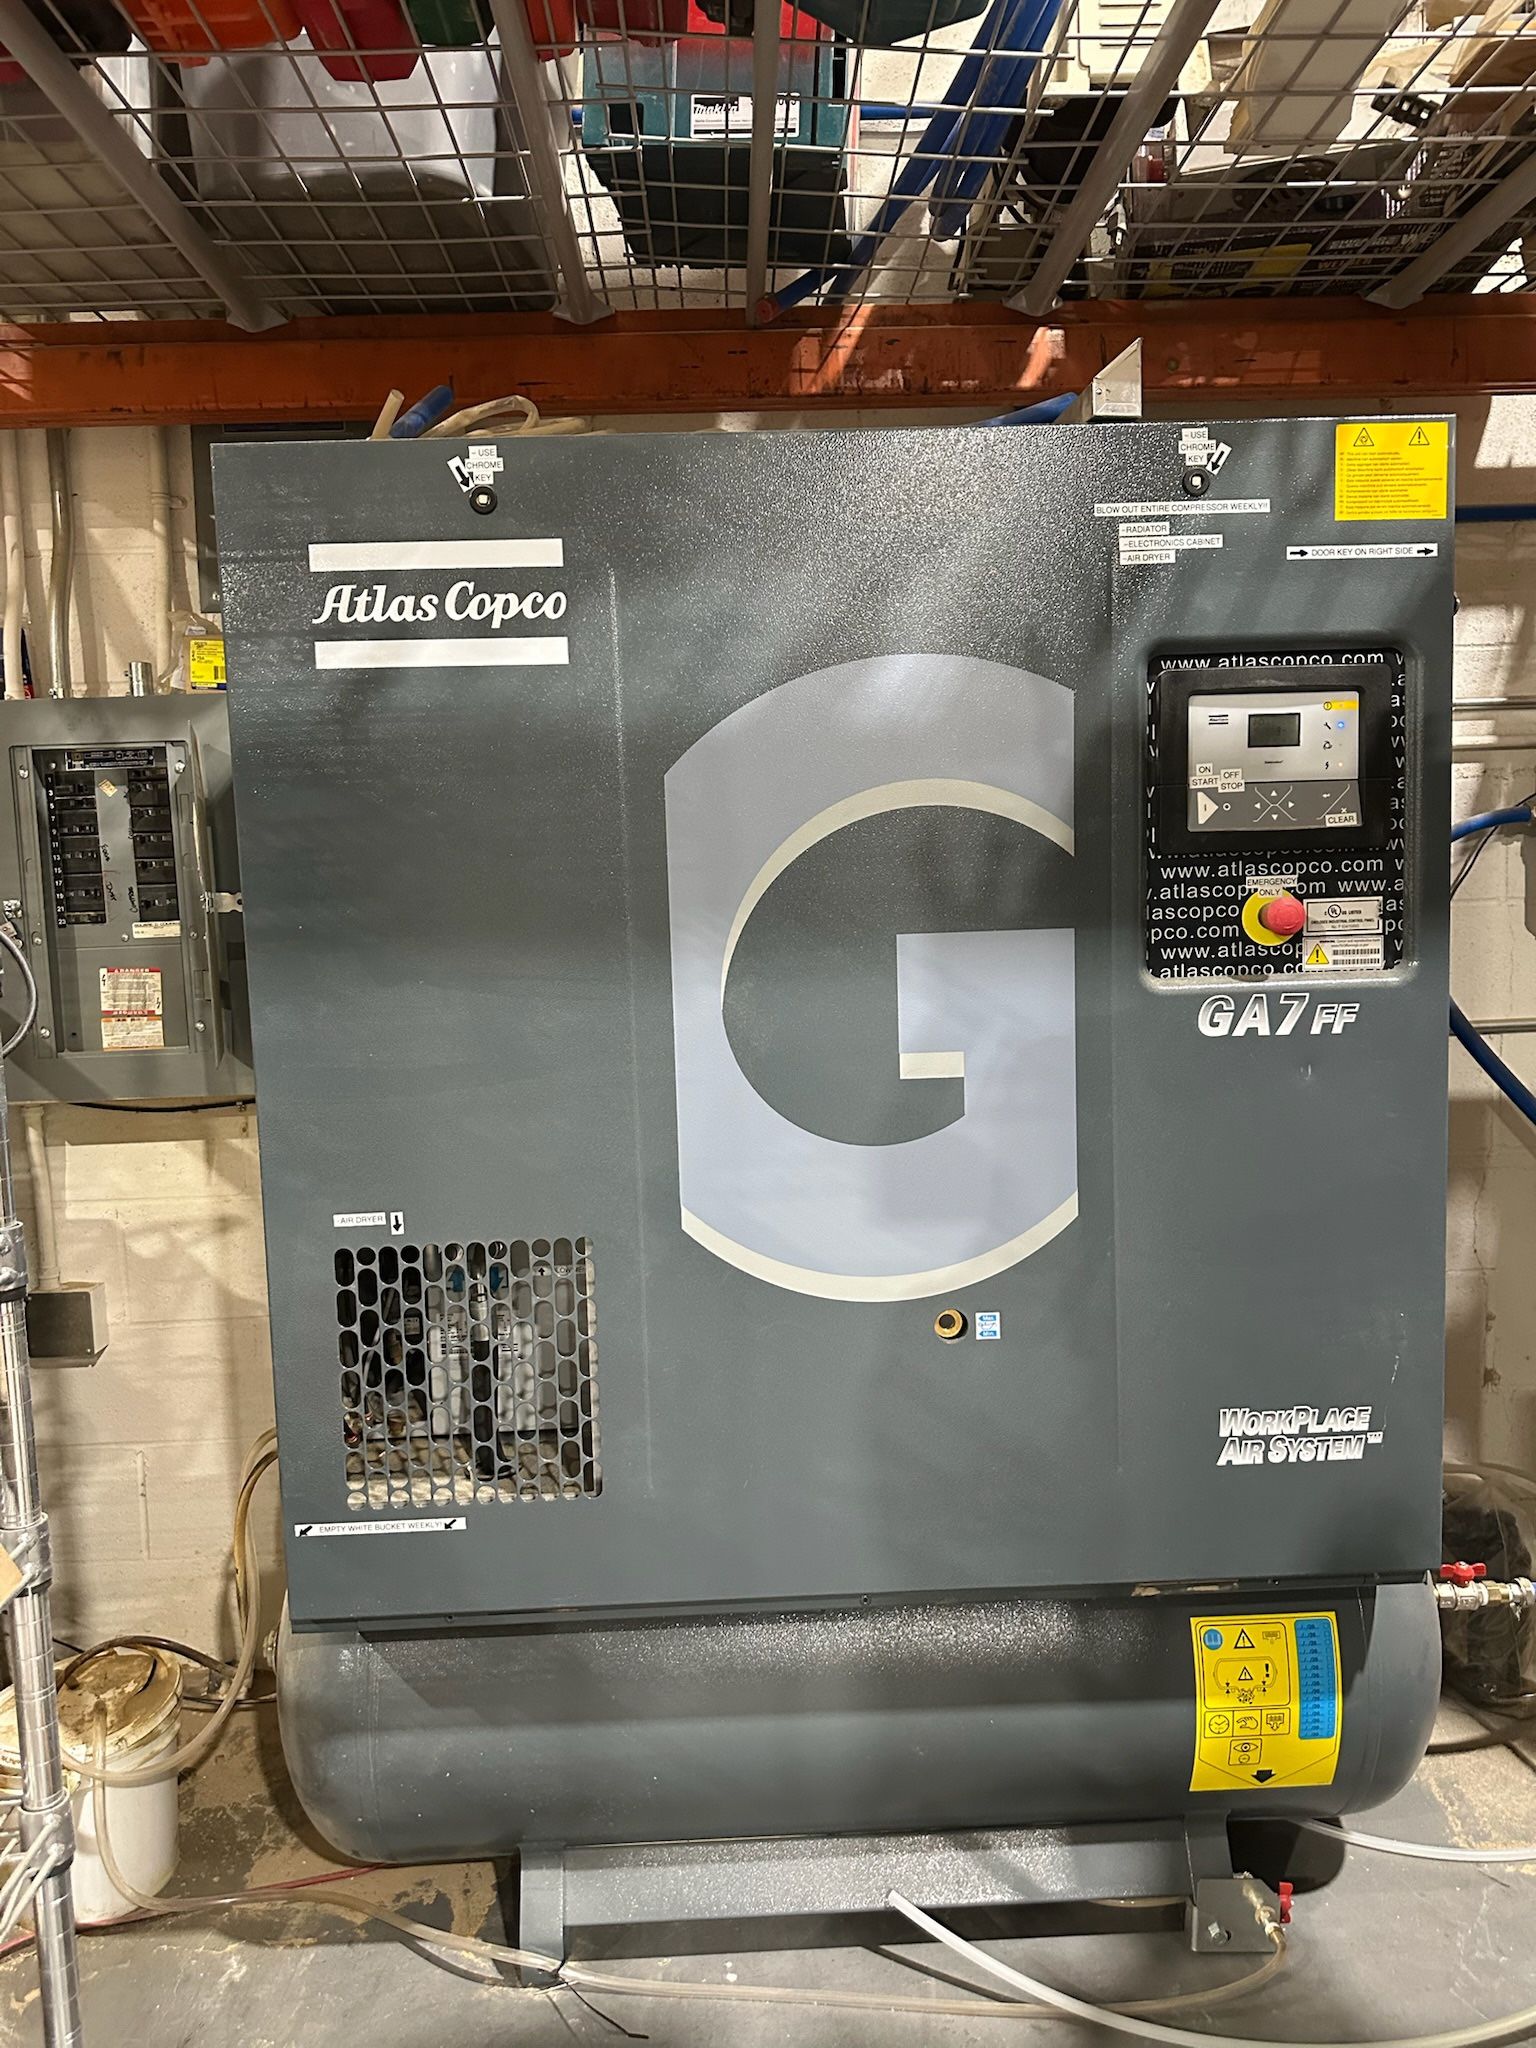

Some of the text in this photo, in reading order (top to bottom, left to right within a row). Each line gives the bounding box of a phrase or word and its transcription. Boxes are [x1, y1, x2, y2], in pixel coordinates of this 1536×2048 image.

[1190, 431, 1207, 439] USE
[1180, 443, 1215, 451] CHROME
[478, 449, 495, 457] USE
[466, 461, 502, 469] CHROME
[1096, 505, 1119, 514] BLOW
[1121, 505, 1138, 514] OUT
[1141, 504, 1170, 513] ENTIRE
[1171, 503, 1228, 512] COMPRESSOR
[1186, 537, 1220, 546] CABINET
[1311, 547, 1413, 557] DOOR KEY ON RIGHT SIDE
[1143, 553, 1170, 561] DRYER
[312, 581, 567, 629] Atlas Copco
[1198, 765, 1212, 774] ON
[1223, 771, 1240, 780] OFF
[1191, 777, 1219, 786] START
[1220, 781, 1243, 790] STOP
[1328, 815, 1355, 825] CLEAR
[1161, 858, 1384, 880] www.atlascopco.com
[1247, 877, 1297, 886] EMERGENCY
[1259, 888, 1281, 897] ONLY
[1198, 993, 1360, 1037] GA7 FF
[355, 1215, 384, 1224] DRYER
[319, 1525, 346, 1533] EMPTY
[348, 1524, 372, 1532] WHITE
[374, 1522, 405, 1531] BUCKET
